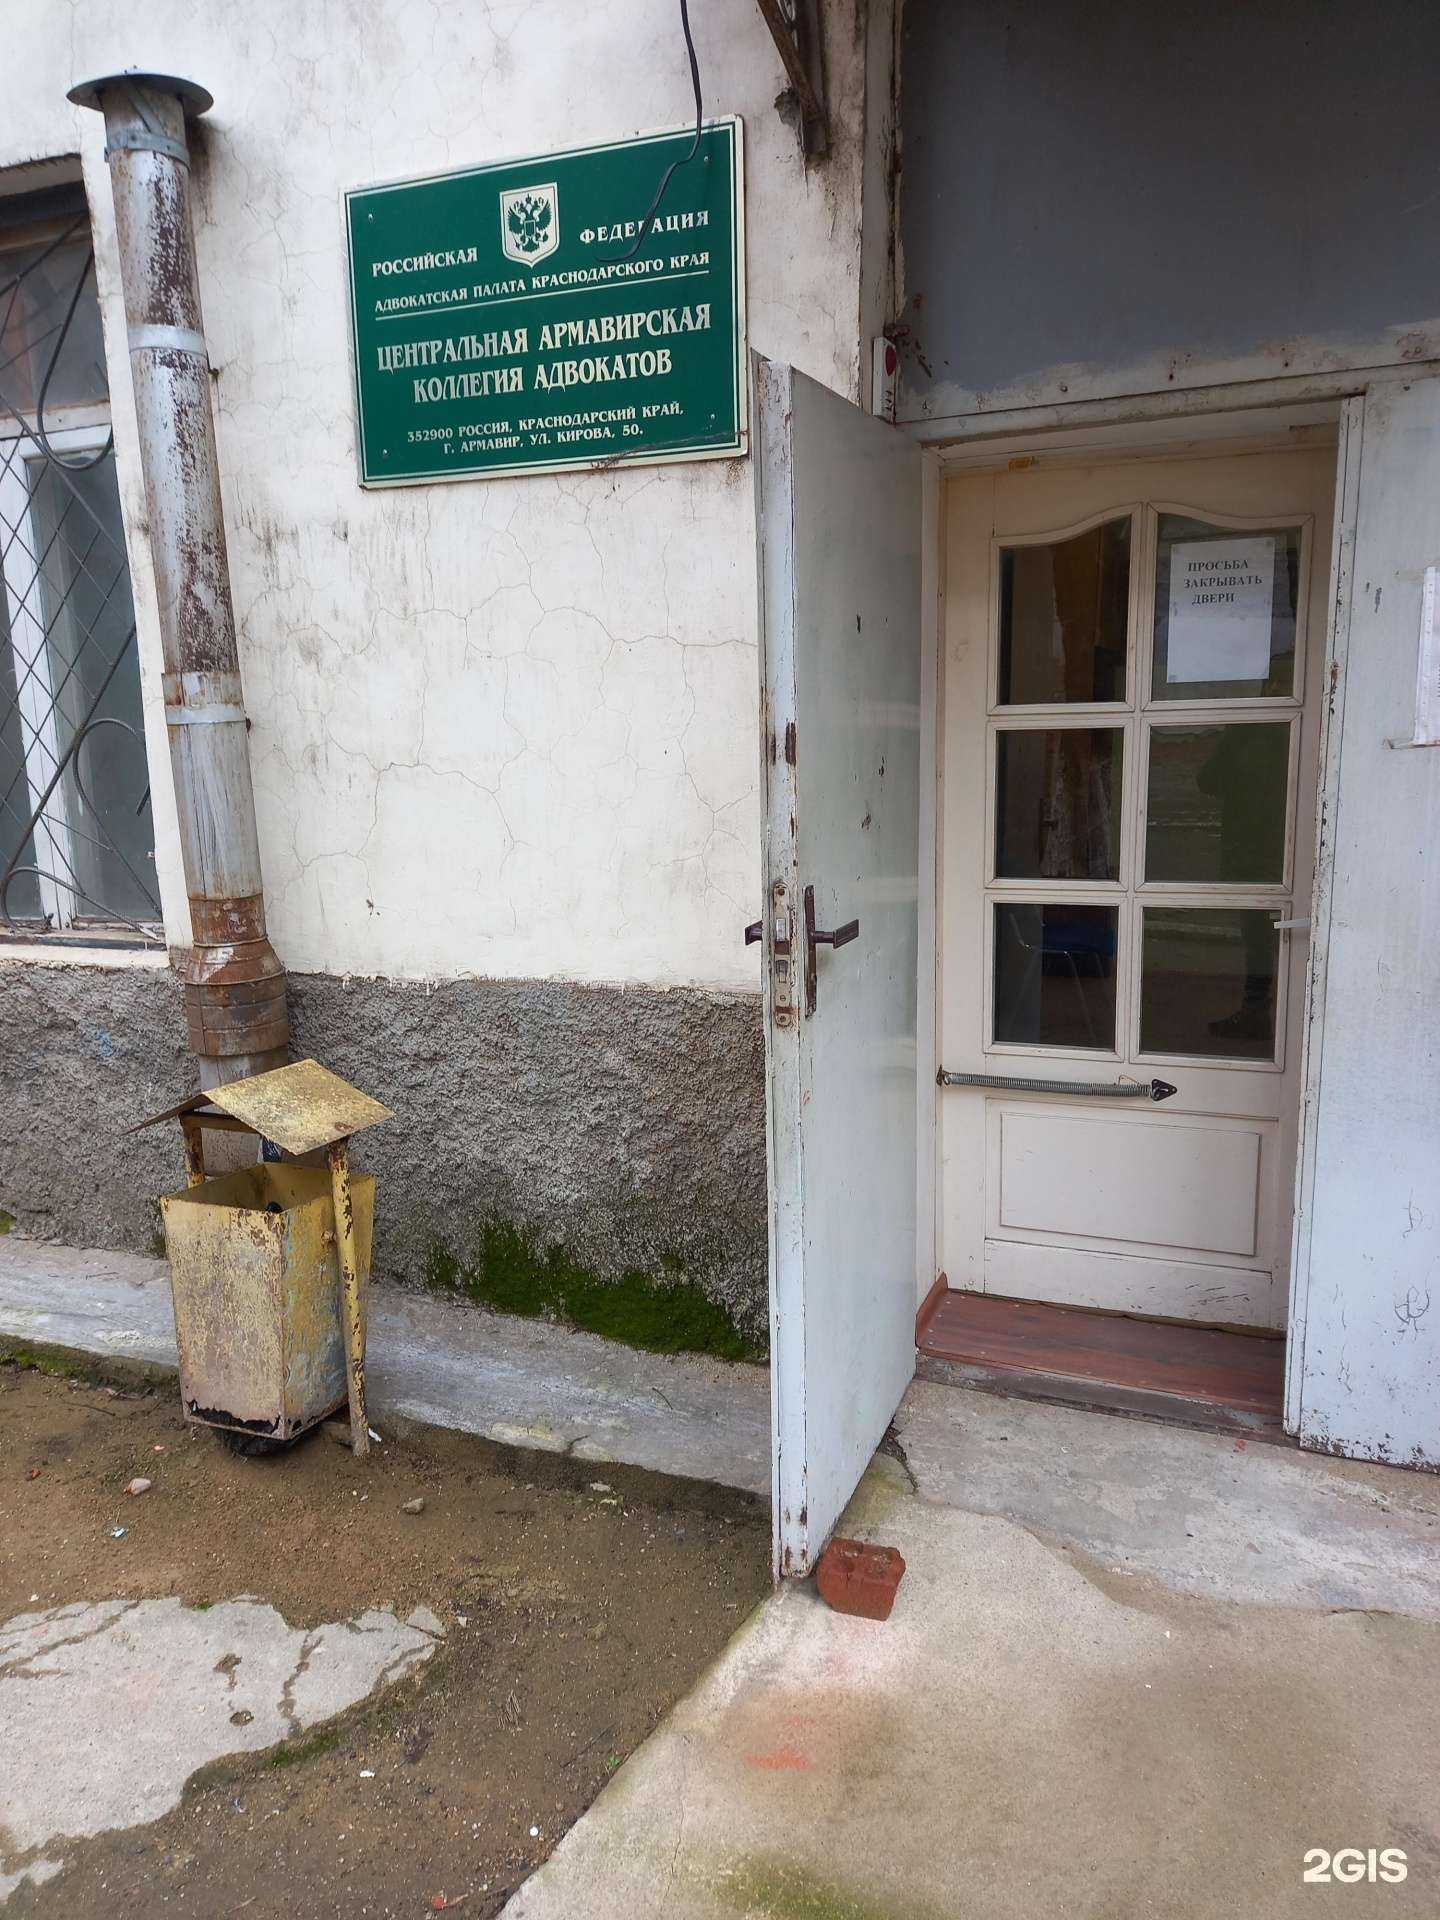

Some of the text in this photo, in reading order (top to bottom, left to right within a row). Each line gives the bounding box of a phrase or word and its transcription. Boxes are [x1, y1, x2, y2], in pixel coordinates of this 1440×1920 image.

[372, 247, 478, 278] РОССИЙСКАЯ
[375, 251, 710, 313] АДВОКАТСКАЯ ПАЛАТА КРАСНОДАРСКОГО КРАЯ
[377, 303, 712, 375] ЦЕНТРАЛЬНАЯ АРМАВИРСКАЯ
[414, 348, 673, 403] КОЛЛЕГИЯ АДВОКАТОВ
[407, 427, 453, 443] 352900
[519, 406, 636, 432] КРАСНОДАРСКИЙ
[443, 443, 455, 455] Г.
[529, 432, 551, 446] УЛ.
[622, 423, 644, 437] 50.
[1184, 575, 1263, 589] ЗАКРЫВАТЬ
[1188, 560, 1249, 572] ПРОСЬБА
[1191, 593, 1235, 606] ДВЕРИ
